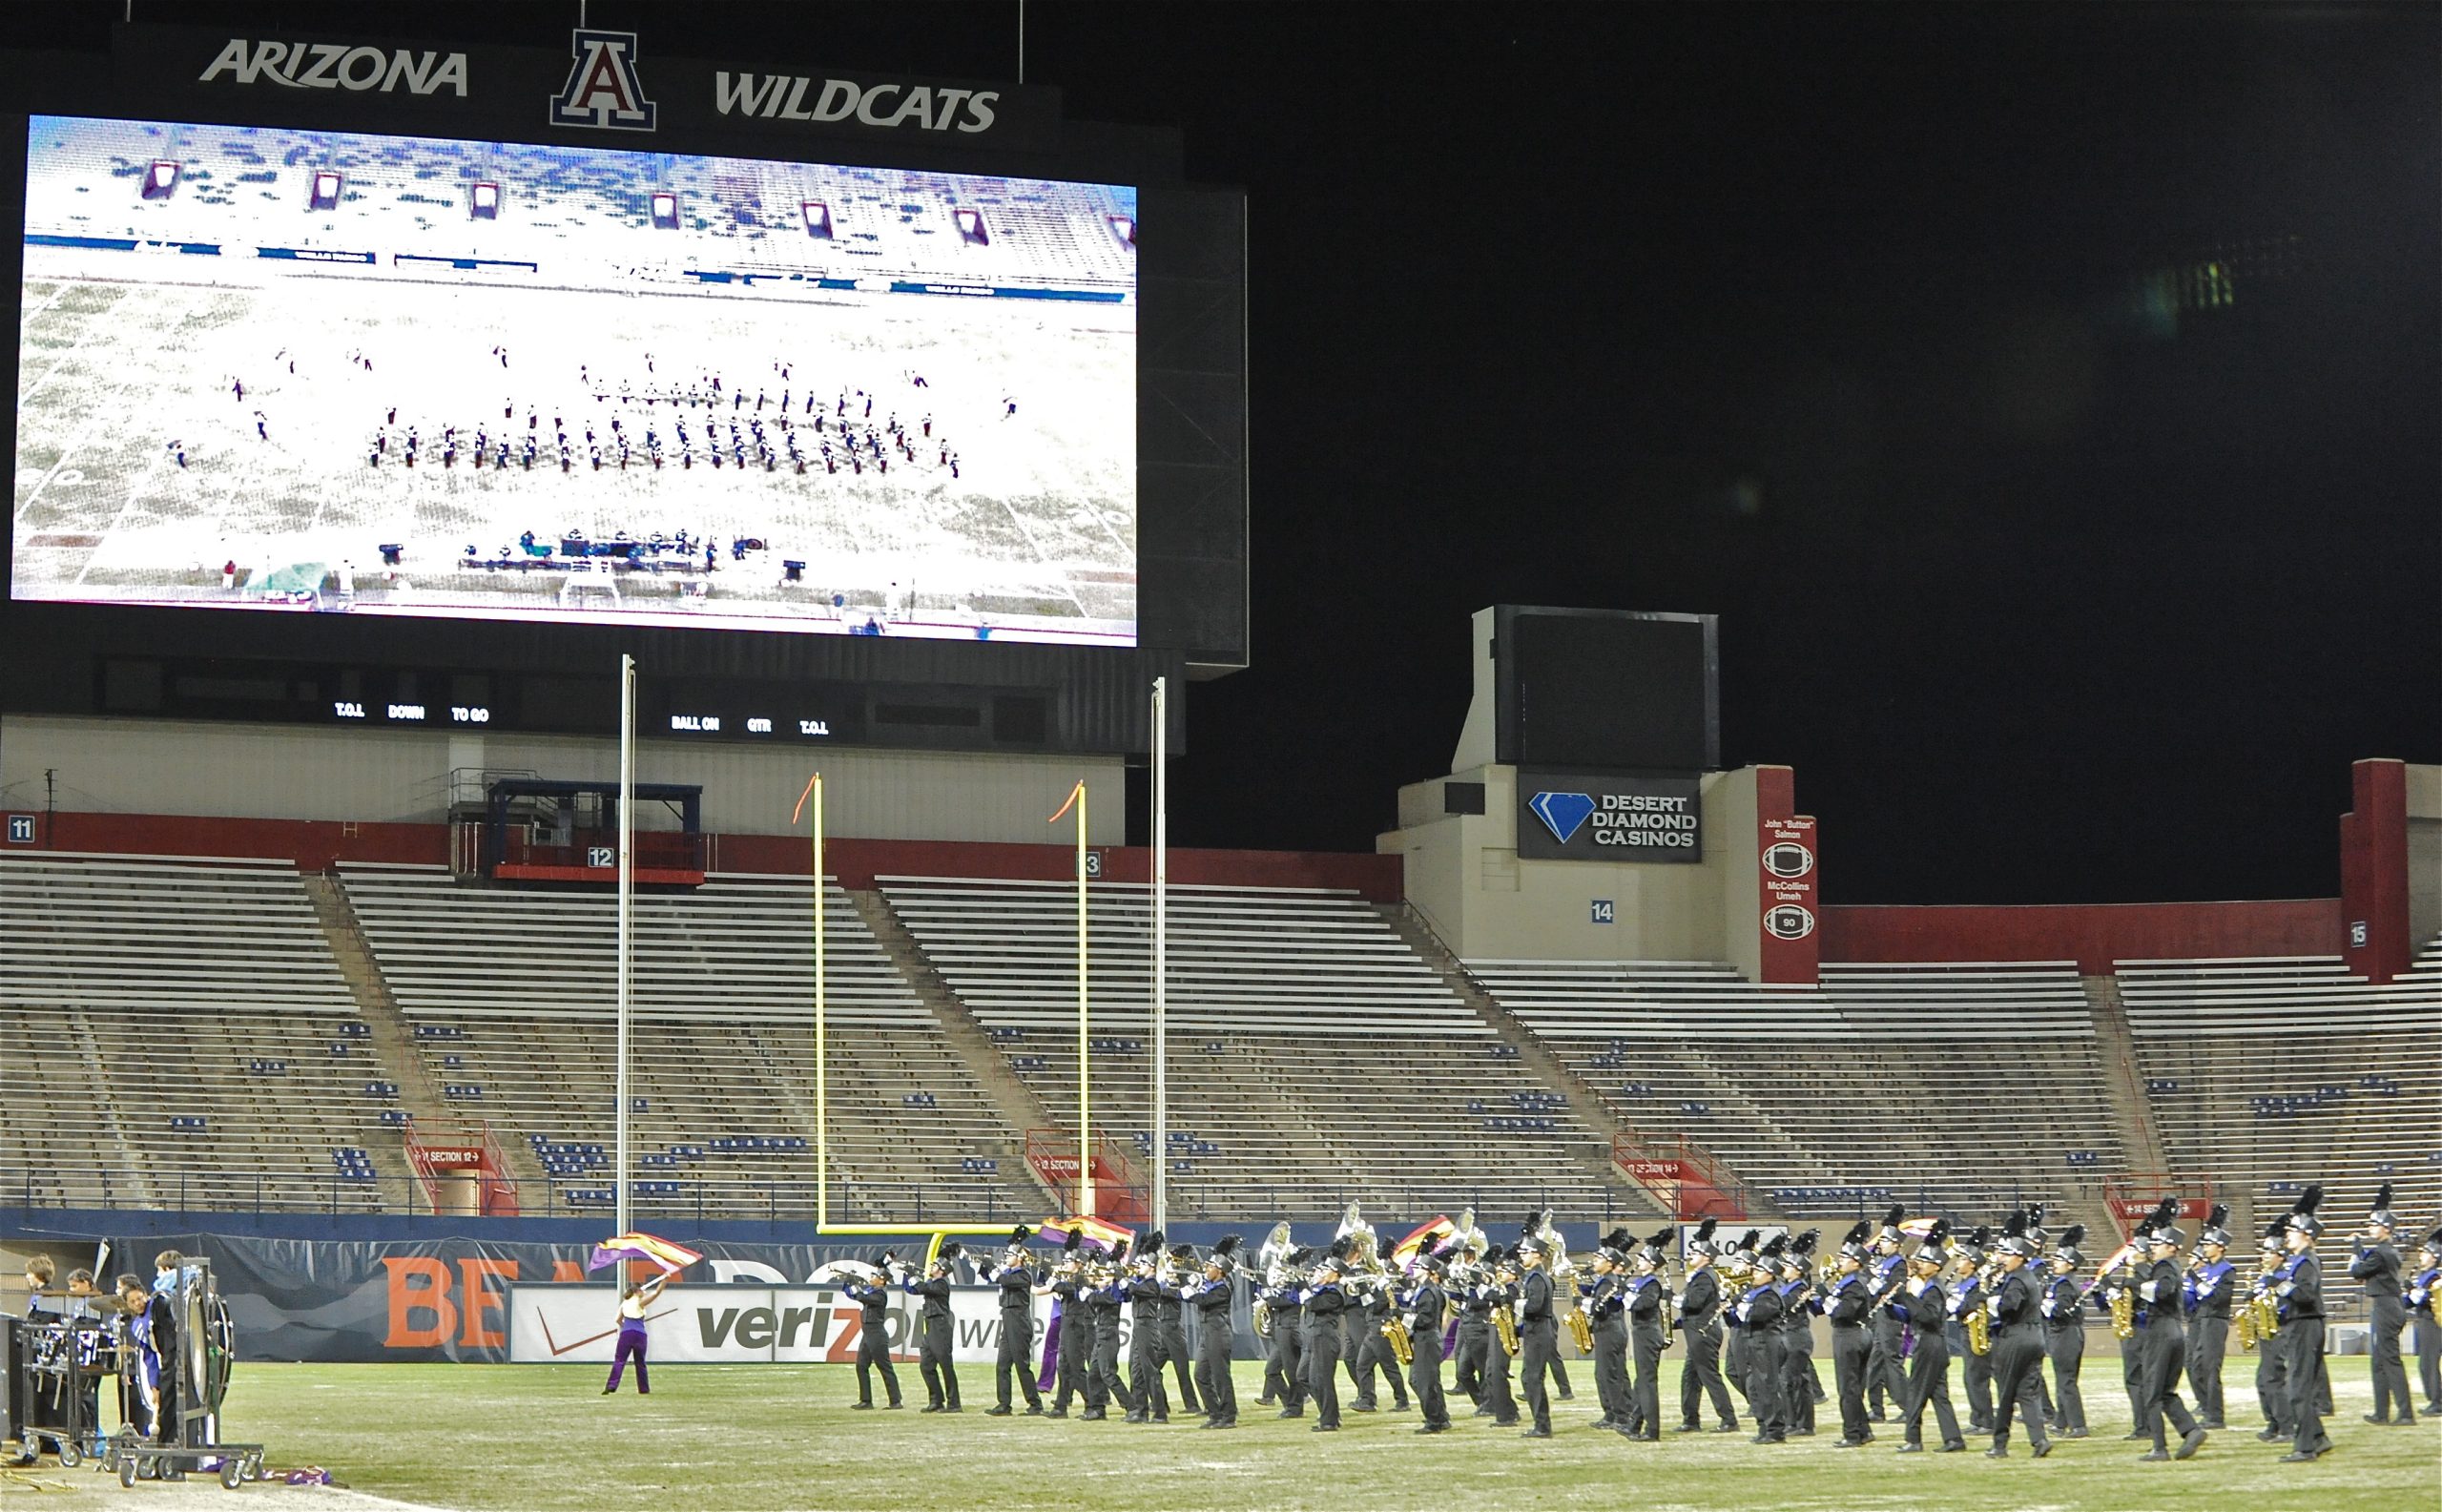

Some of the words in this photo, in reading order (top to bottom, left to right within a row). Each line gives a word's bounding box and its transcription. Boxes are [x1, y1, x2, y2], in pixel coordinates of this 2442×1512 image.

[198, 38, 467, 97] ARIZONA
[549, 29, 656, 132] A
[715, 71, 999, 133] WILDCATS
[388, 704, 424, 719] DOWN
[451, 707, 468, 721] TO
[470, 708, 489, 722] GO
[672, 715, 701, 730] BALL
[702, 717, 720, 731] ON
[747, 718, 772, 732] QTR
[1603, 795, 1687, 812] DESERT
[1592, 812, 1697, 829] DIAMOND
[1765, 819, 1782, 828] John
[12, 819, 31, 838] 11
[1774, 830, 1801, 839] Salmon
[1595, 830, 1694, 847] CASINOS
[590, 849, 611, 866] 12
[1768, 881, 1810, 890] McCollins
[1776, 892, 1801, 901] Umeh
[1592, 903, 1612, 921] 14
[1783, 918, 1795, 927] 90
[2351, 925, 2366, 942] 15
[430, 1151, 462, 1162] SECTION
[464, 1151, 471, 1162] 12
[1050, 1160, 1079, 1170] SECTION
